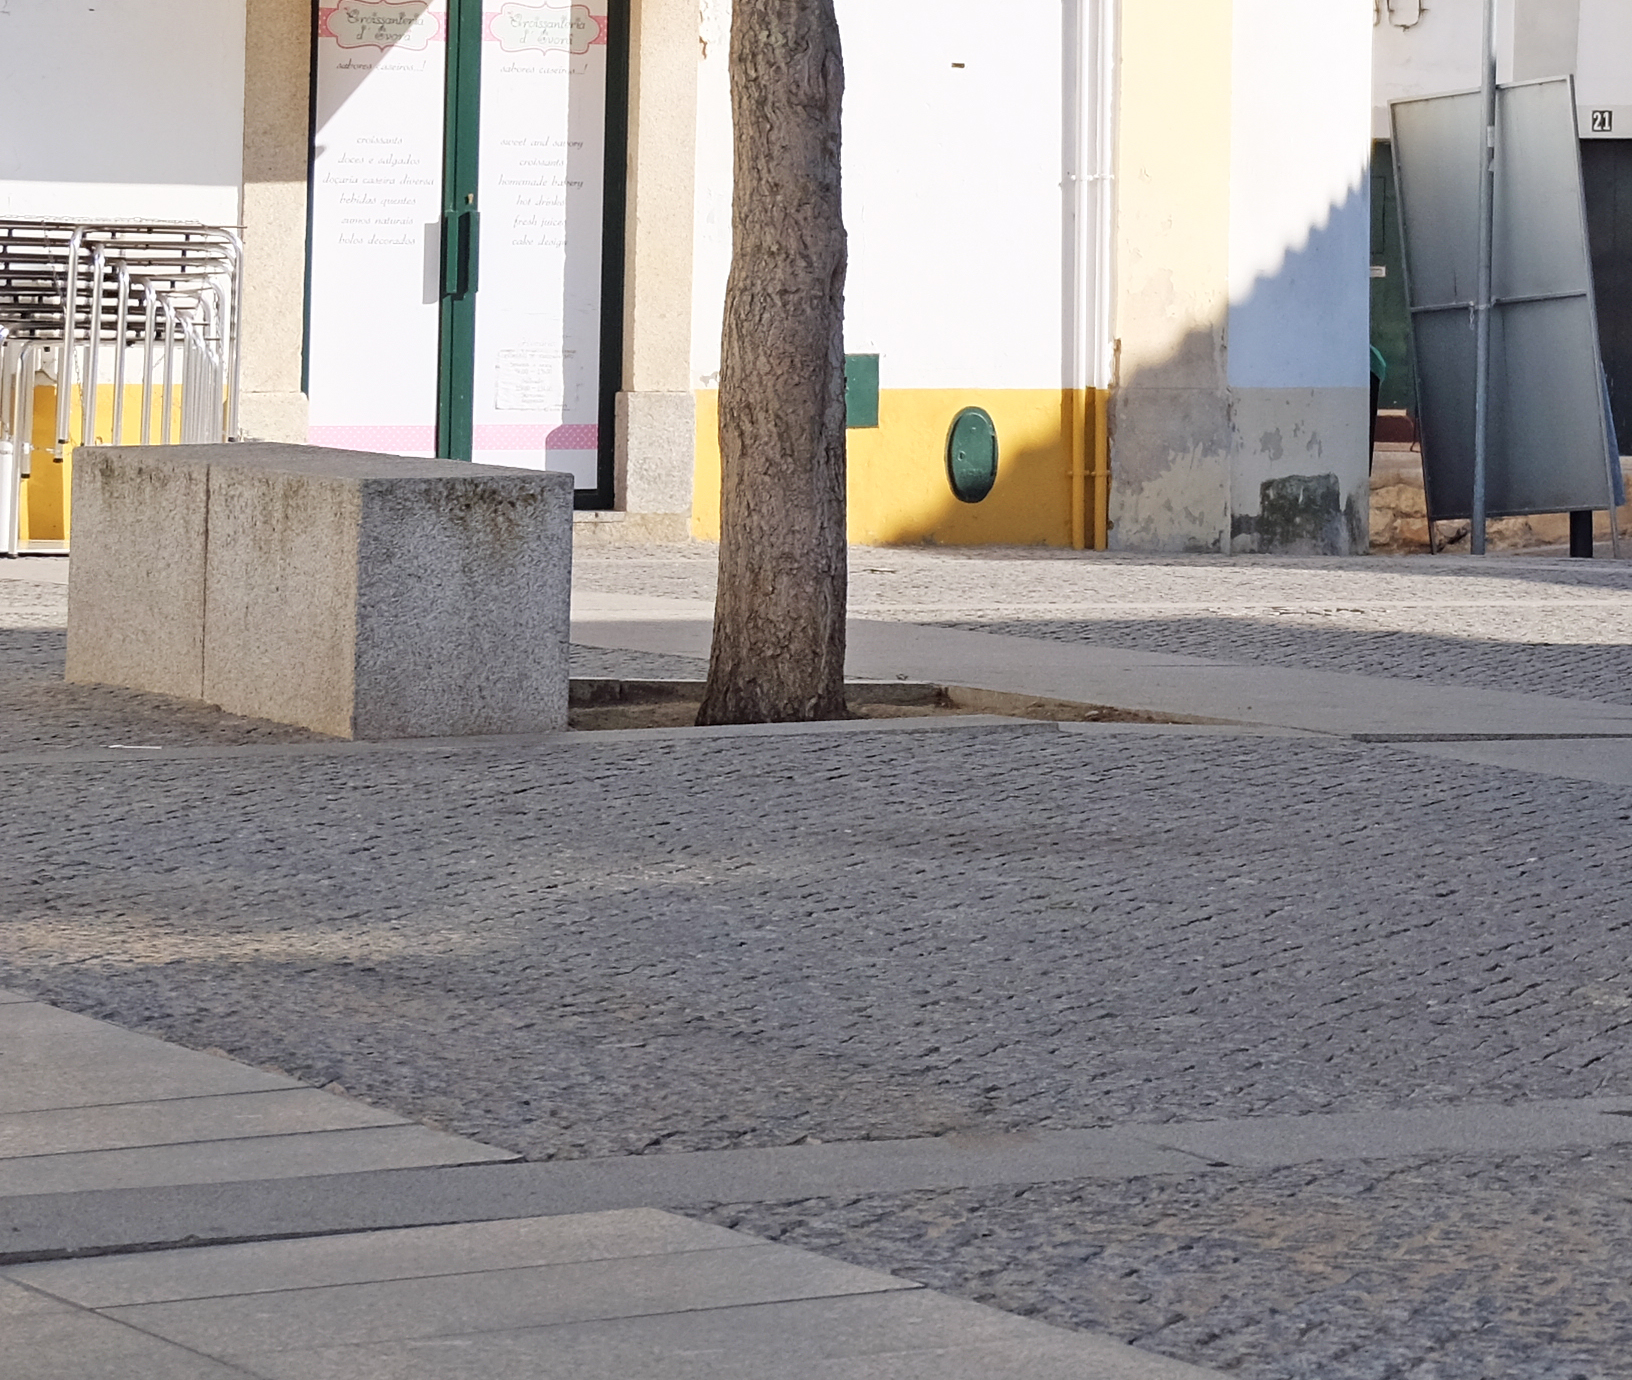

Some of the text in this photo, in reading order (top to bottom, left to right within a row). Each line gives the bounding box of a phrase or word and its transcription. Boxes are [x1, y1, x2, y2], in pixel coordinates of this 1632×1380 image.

[1593, 111, 1611, 131] 21
[500, 137, 527, 147] sweet
[530, 136, 550, 147] and
[337, 152, 421, 167] doces e salgados
[399, 173, 435, 186] diversa
[498, 173, 548, 187] homemade
[339, 192, 417, 208] bebidas quentes
[516, 194, 565, 207] hot drinks
[374, 216, 414, 225] naturais
[513, 214, 537, 229] fresh
[338, 232, 416, 245] bolos decorados
[512, 234, 534, 246] cake
